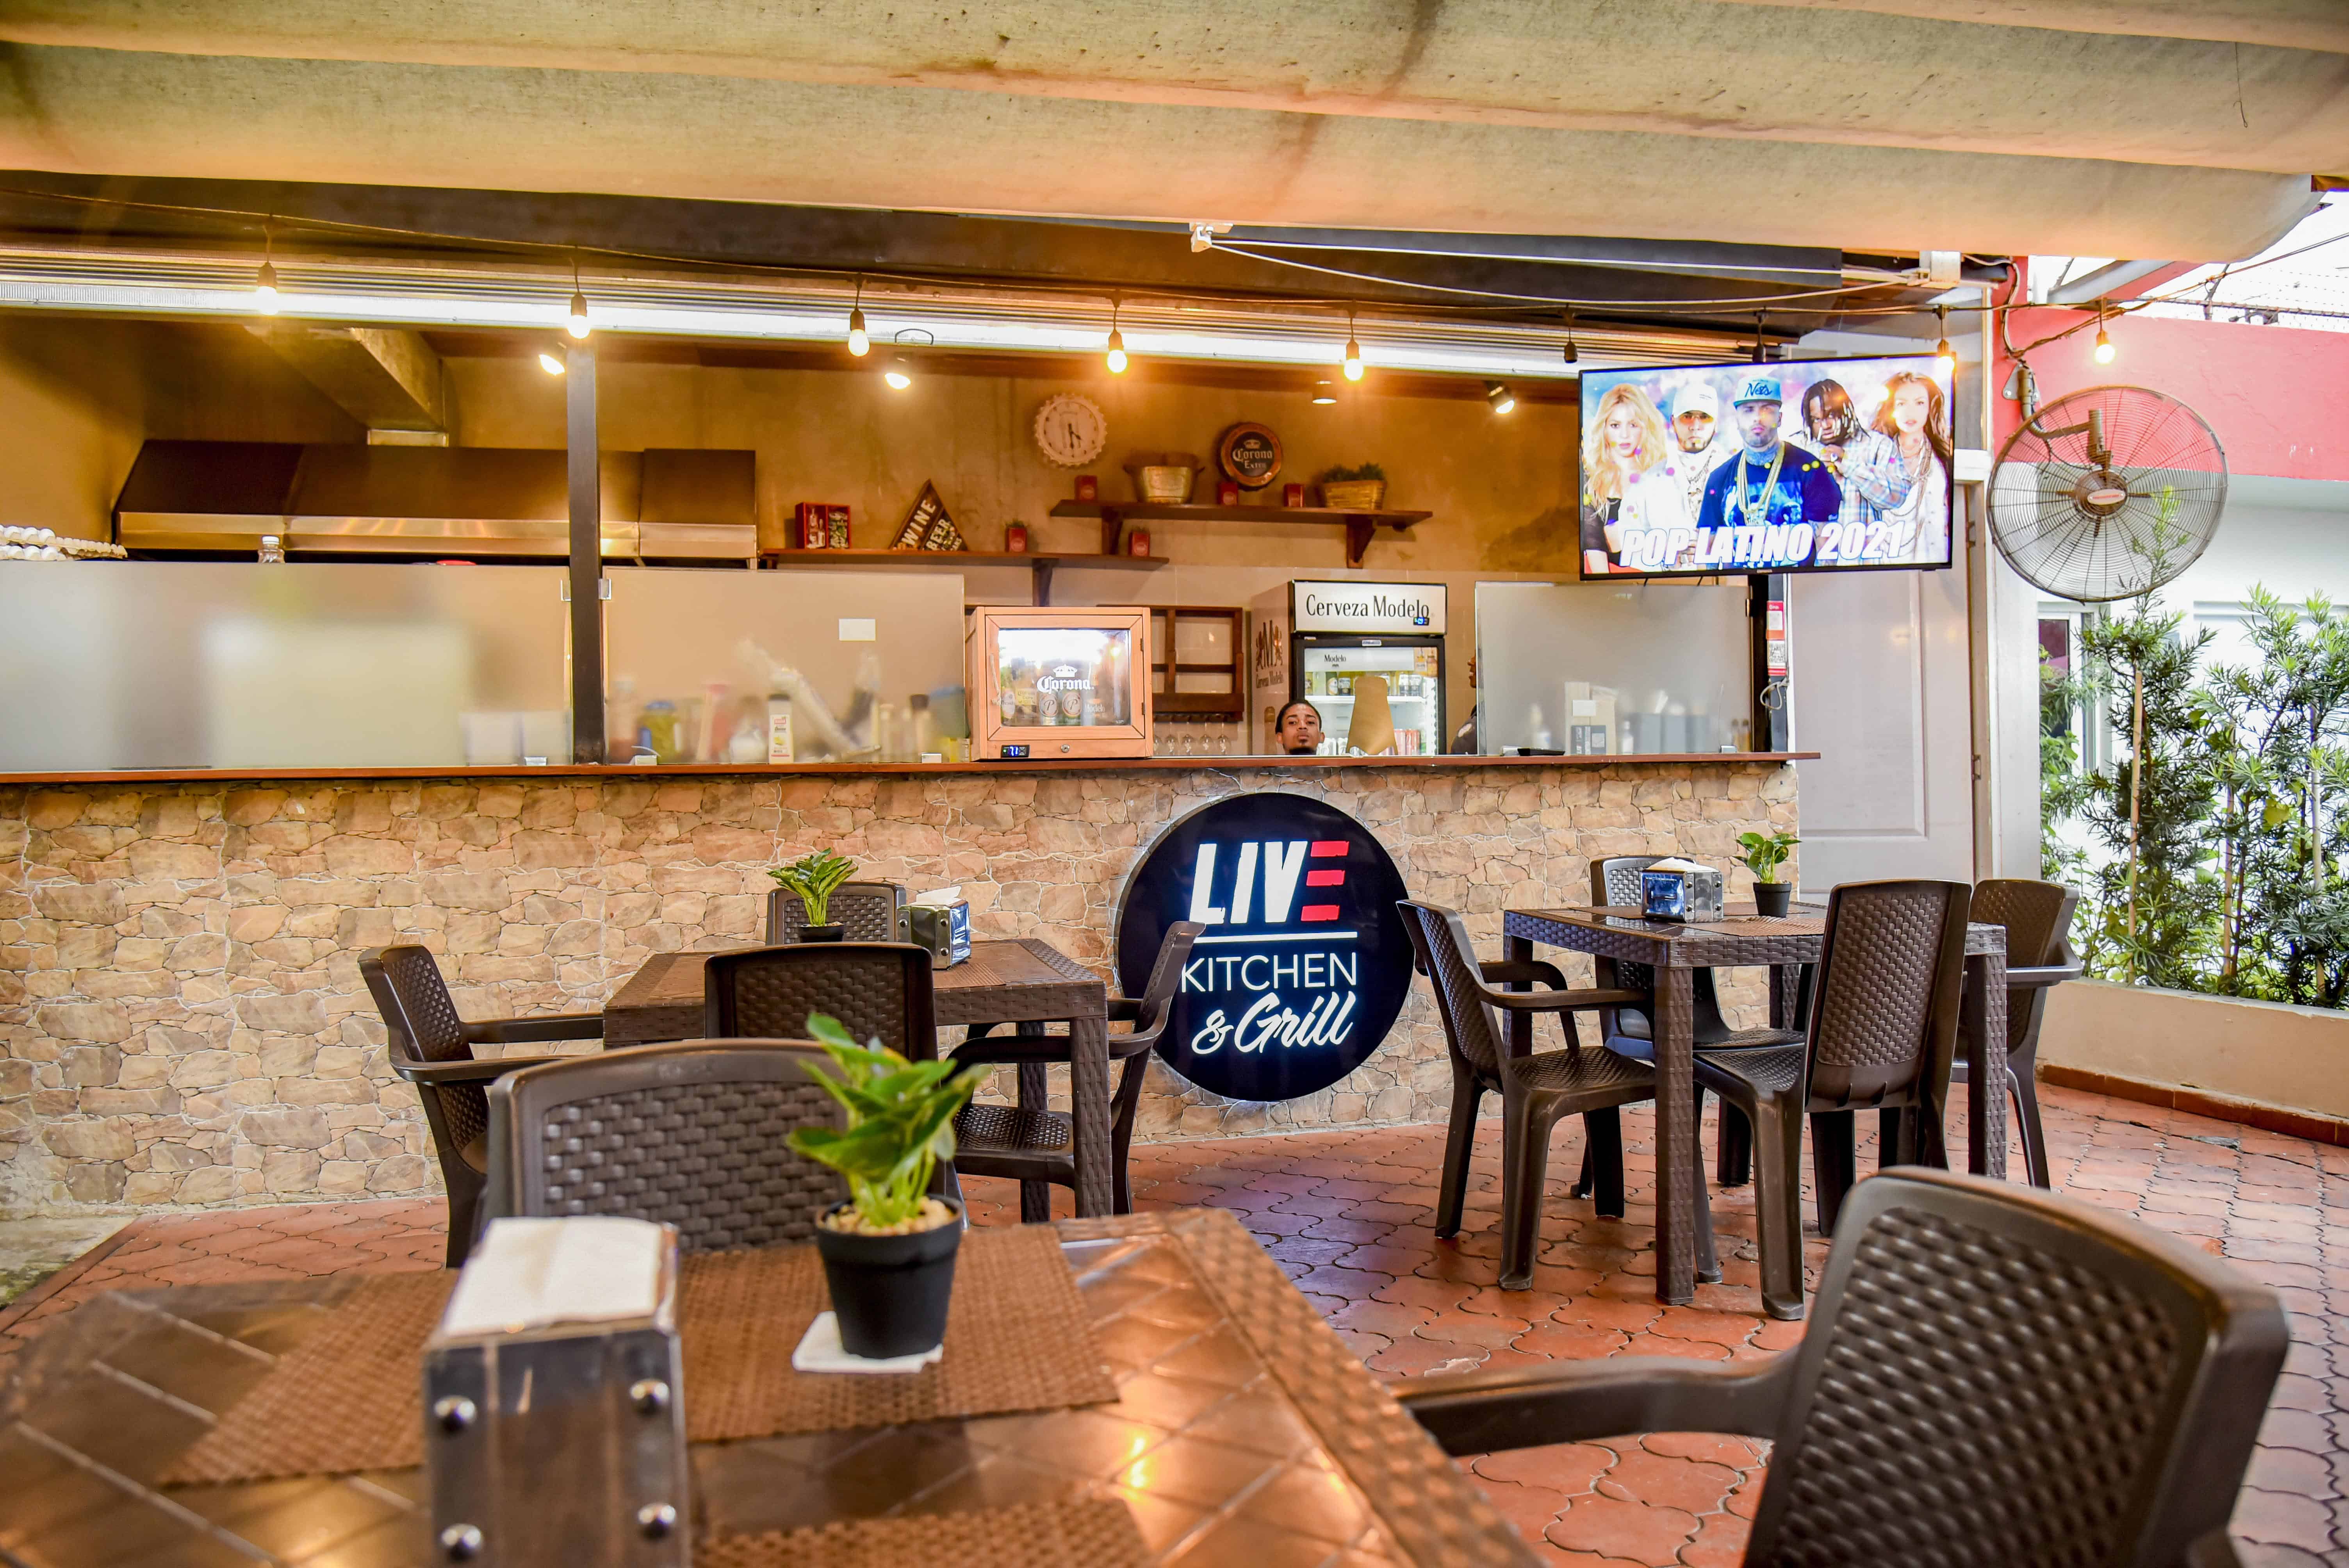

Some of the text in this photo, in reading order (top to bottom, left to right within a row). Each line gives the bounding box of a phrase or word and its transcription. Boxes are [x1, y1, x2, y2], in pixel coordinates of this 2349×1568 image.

[1232, 449, 1273, 463] Corona
[901, 499, 936, 545] WINE
[926, 519, 950, 551] BEER
[1620, 520, 1906, 567] POP LATINO 2021
[1306, 594, 1429, 618] Cerveza Modelo
[1324, 654, 1346, 663] Modelo
[1037, 675, 1092, 694] Corona
[1189, 841, 1350, 924] LIVE
[1181, 952, 1357, 993] KITCHEN
[1191, 991, 1357, 1055] & Grill
